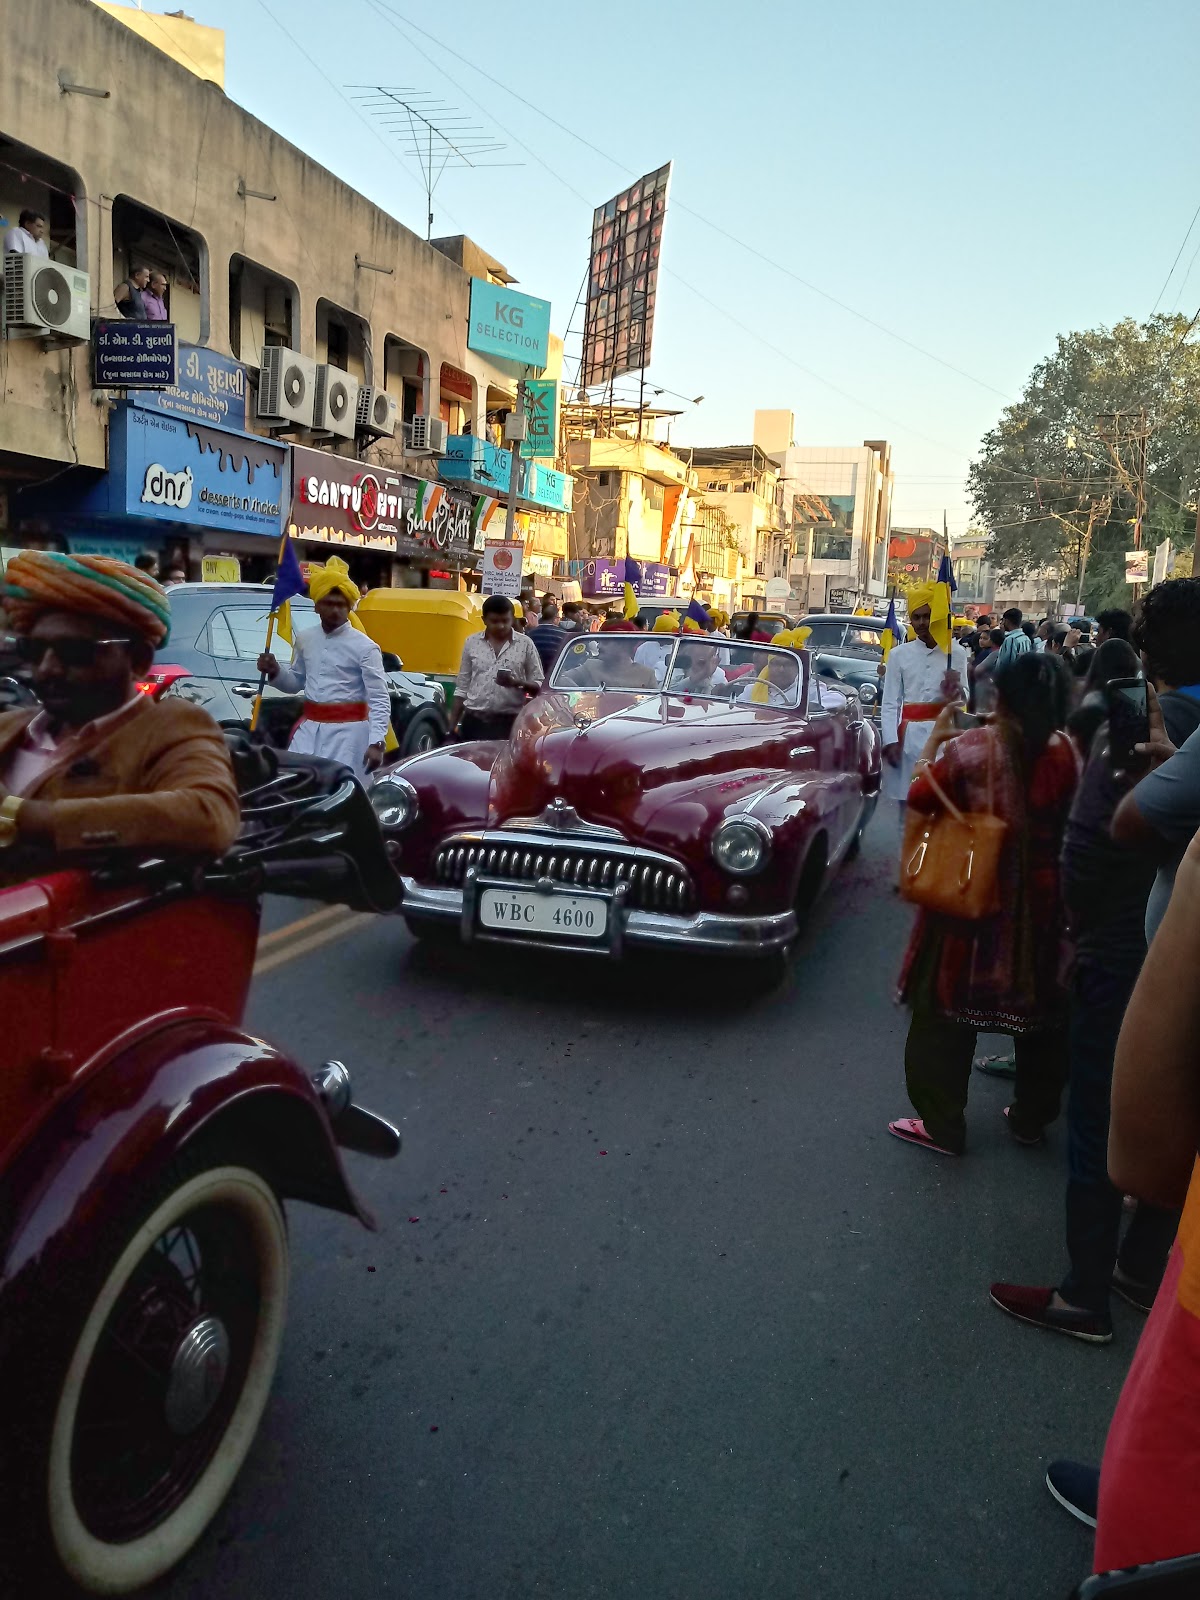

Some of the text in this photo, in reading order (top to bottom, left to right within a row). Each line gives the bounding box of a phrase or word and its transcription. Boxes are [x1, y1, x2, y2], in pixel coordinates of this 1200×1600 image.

[495, 301, 524, 328] KG
[476, 322, 540, 351] SELECTION
[207, 365, 245, 396] સુદાણી
[447, 449, 465, 460] KG
[494, 450, 507, 470] KG
[545, 472, 557, 489] KG
[199, 487, 240, 509] desserts
[493, 901, 595, 928] WBC 4600
